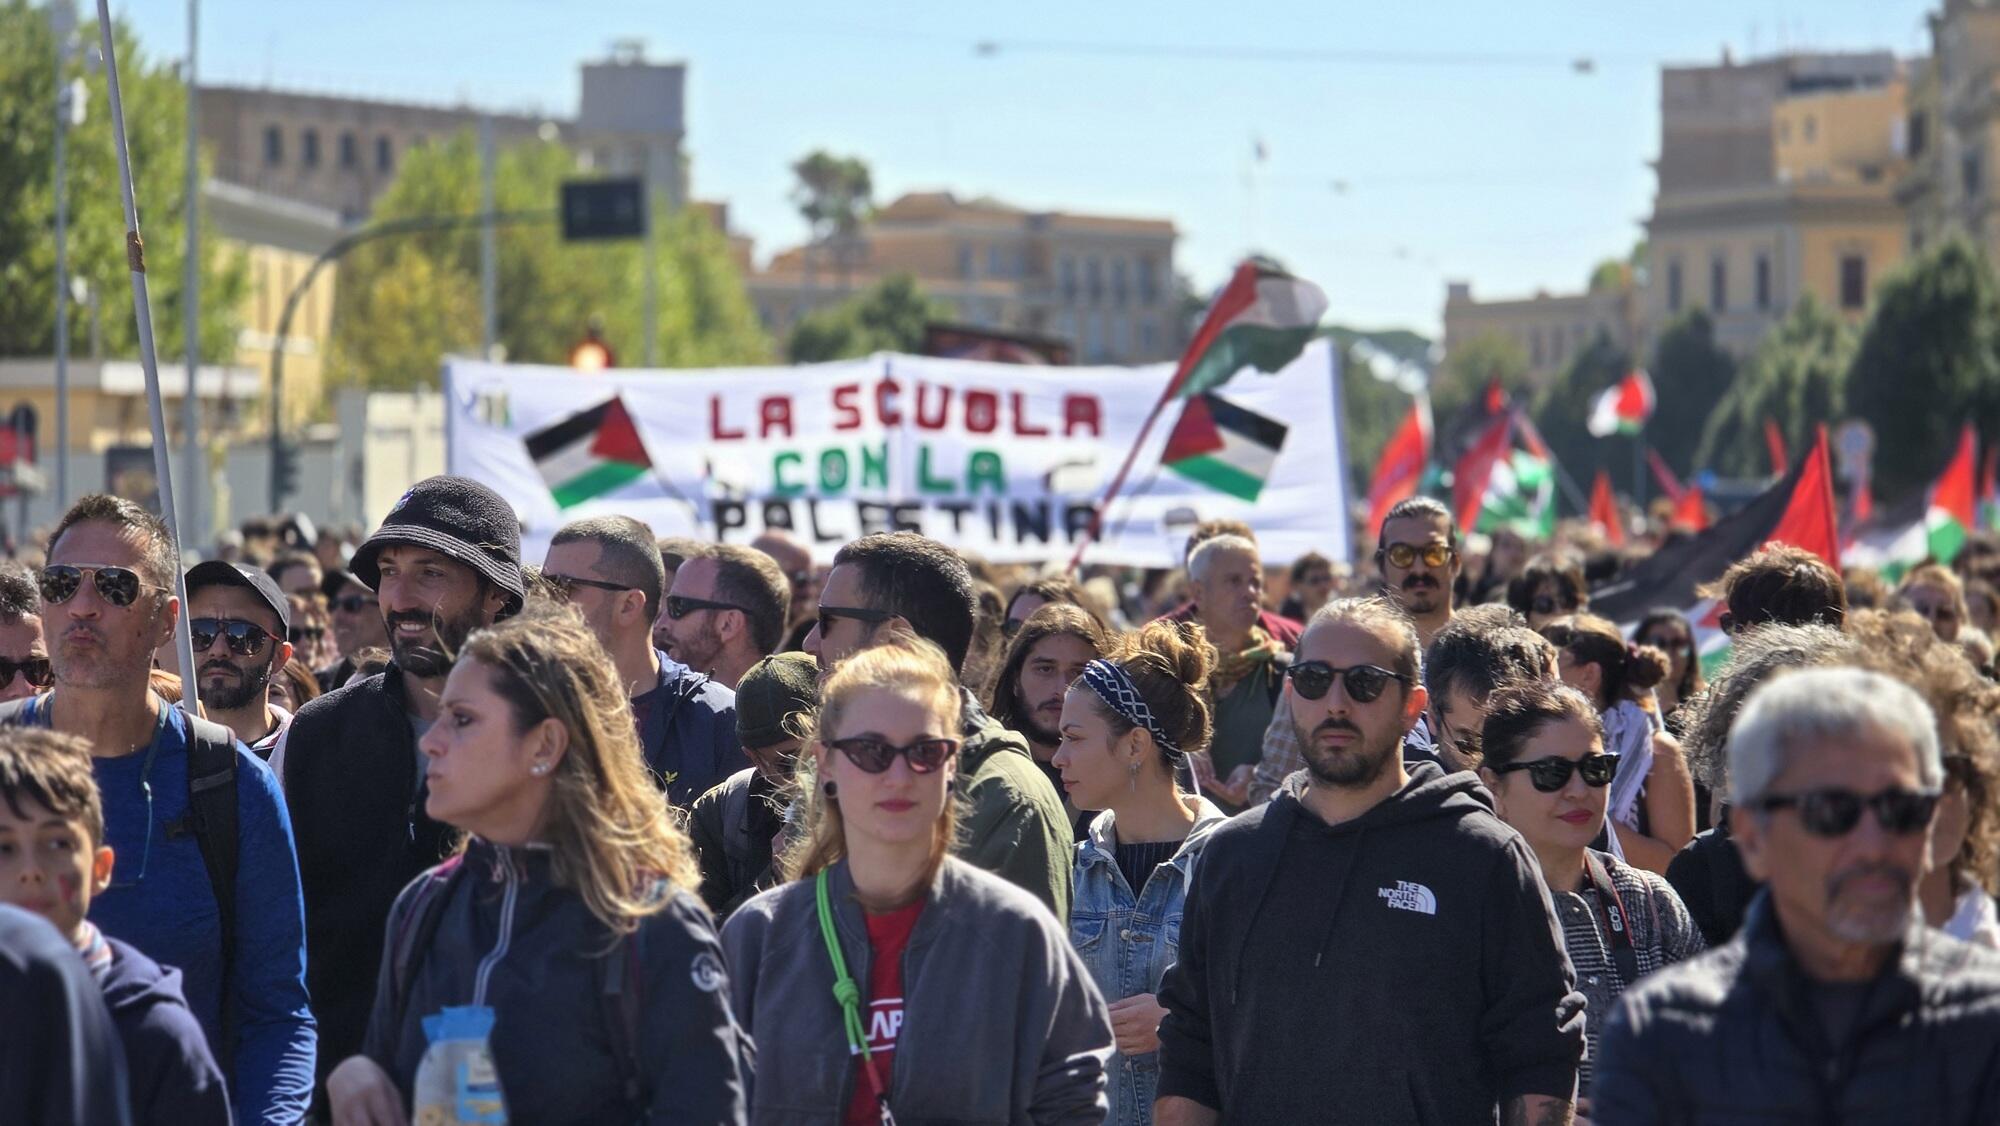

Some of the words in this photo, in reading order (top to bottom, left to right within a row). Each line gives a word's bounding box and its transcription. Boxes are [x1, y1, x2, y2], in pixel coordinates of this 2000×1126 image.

[711, 393, 793, 441] LA
[833, 376, 1102, 438] SCUOLA
[774, 444, 889, 494] CON
[917, 443, 1007, 493] LA
[711, 499, 1102, 543] PALESTINA
[1378, 887, 1417, 901] NORTH
[1396, 880, 1419, 892] THE
[1387, 898, 1419, 911] FACE
[1608, 905, 1623, 932] EOS
